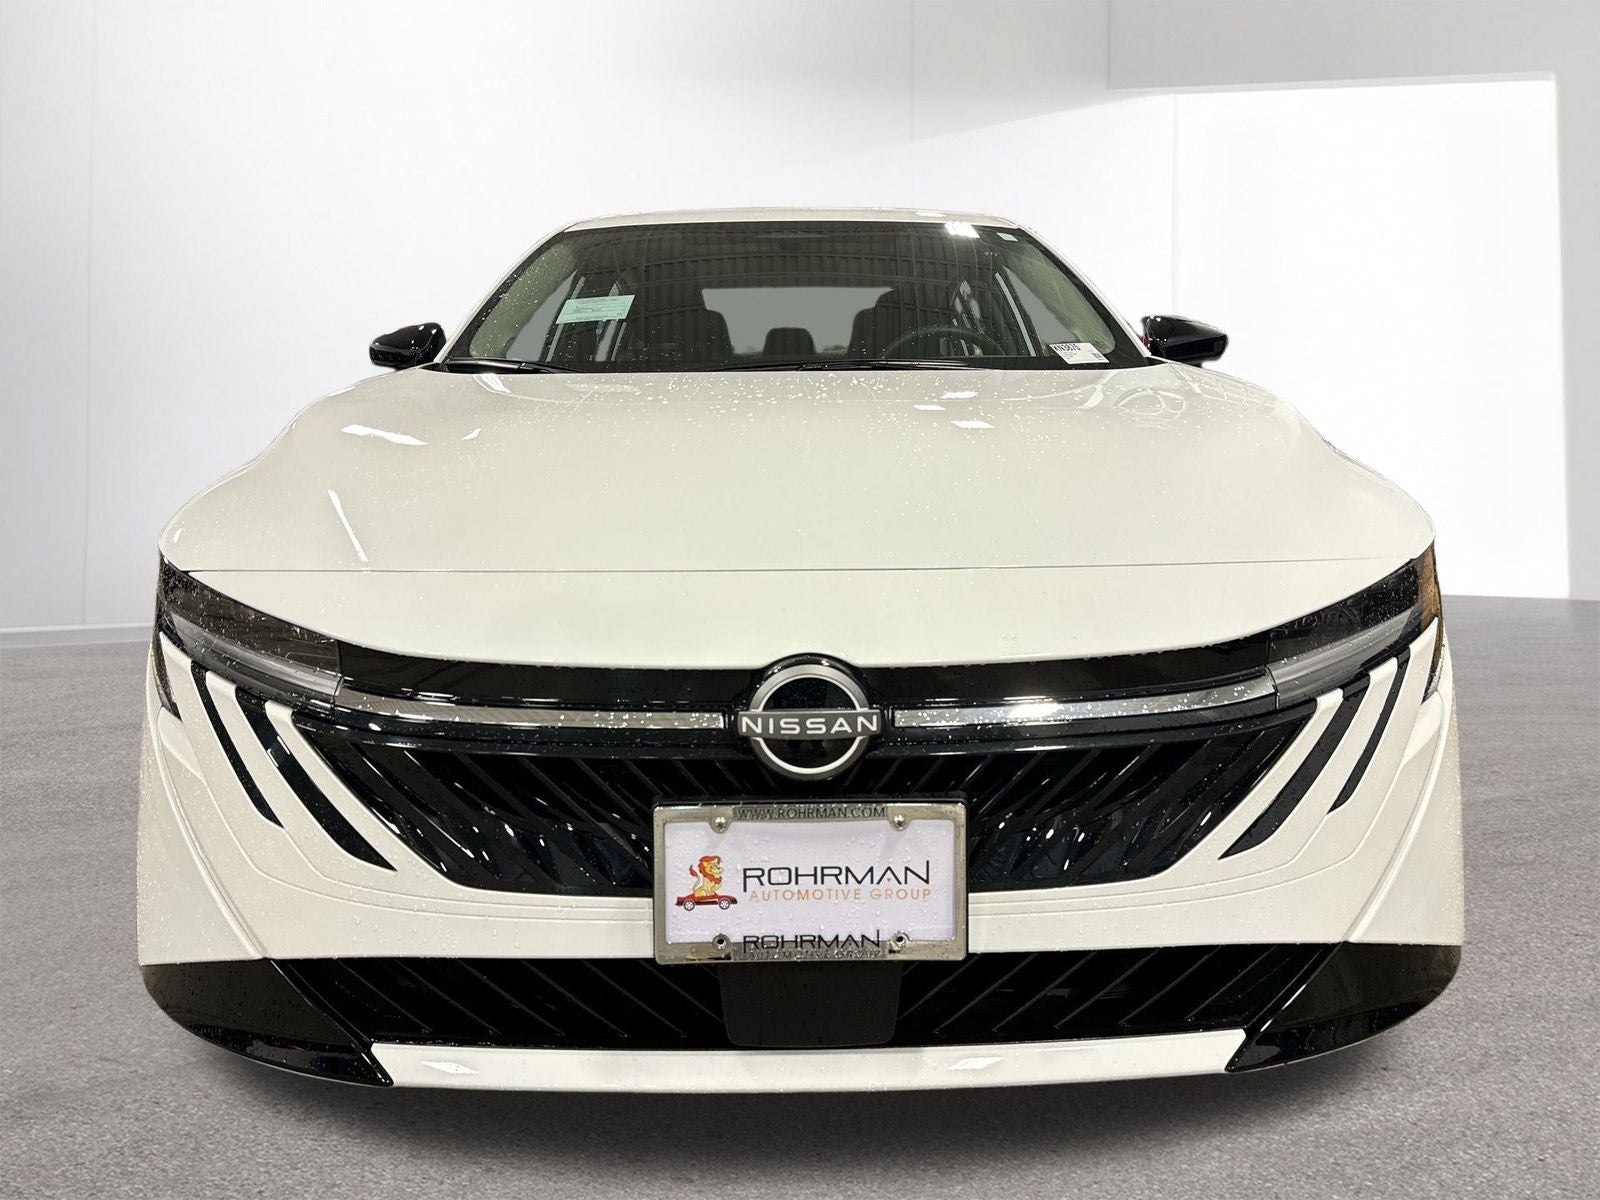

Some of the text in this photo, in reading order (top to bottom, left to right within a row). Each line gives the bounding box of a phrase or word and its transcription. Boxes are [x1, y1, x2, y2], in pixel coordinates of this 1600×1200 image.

[741, 715, 878, 735] NISSAN
[737, 806, 886, 820] WWW.ROHRMAN.COM
[742, 860, 930, 892] ROHRMAN
[749, 888, 931, 902] AUTOMOTIVE GROUP
[742, 930, 881, 953] ROHRMAN
